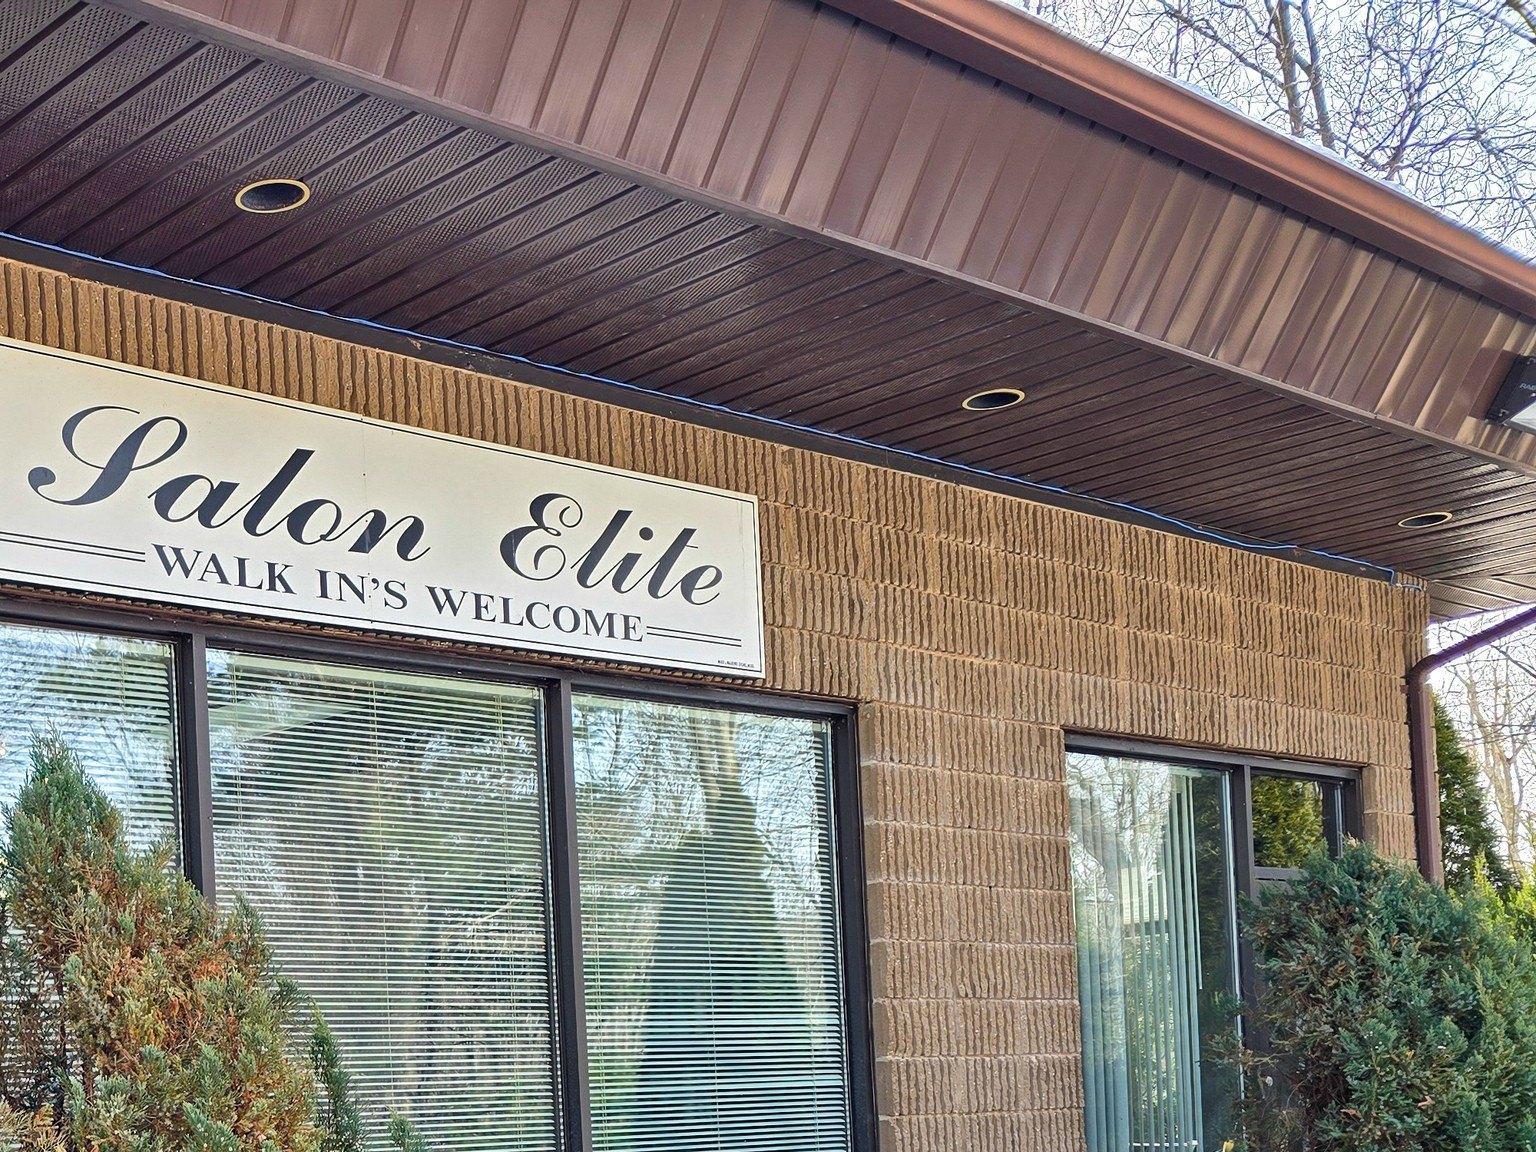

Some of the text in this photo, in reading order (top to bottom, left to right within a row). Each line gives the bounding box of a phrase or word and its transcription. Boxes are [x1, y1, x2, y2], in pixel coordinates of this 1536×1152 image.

[28, 405, 724, 605] Salon Elite
[152, 544, 644, 642] WALK IN'S WELCOME
